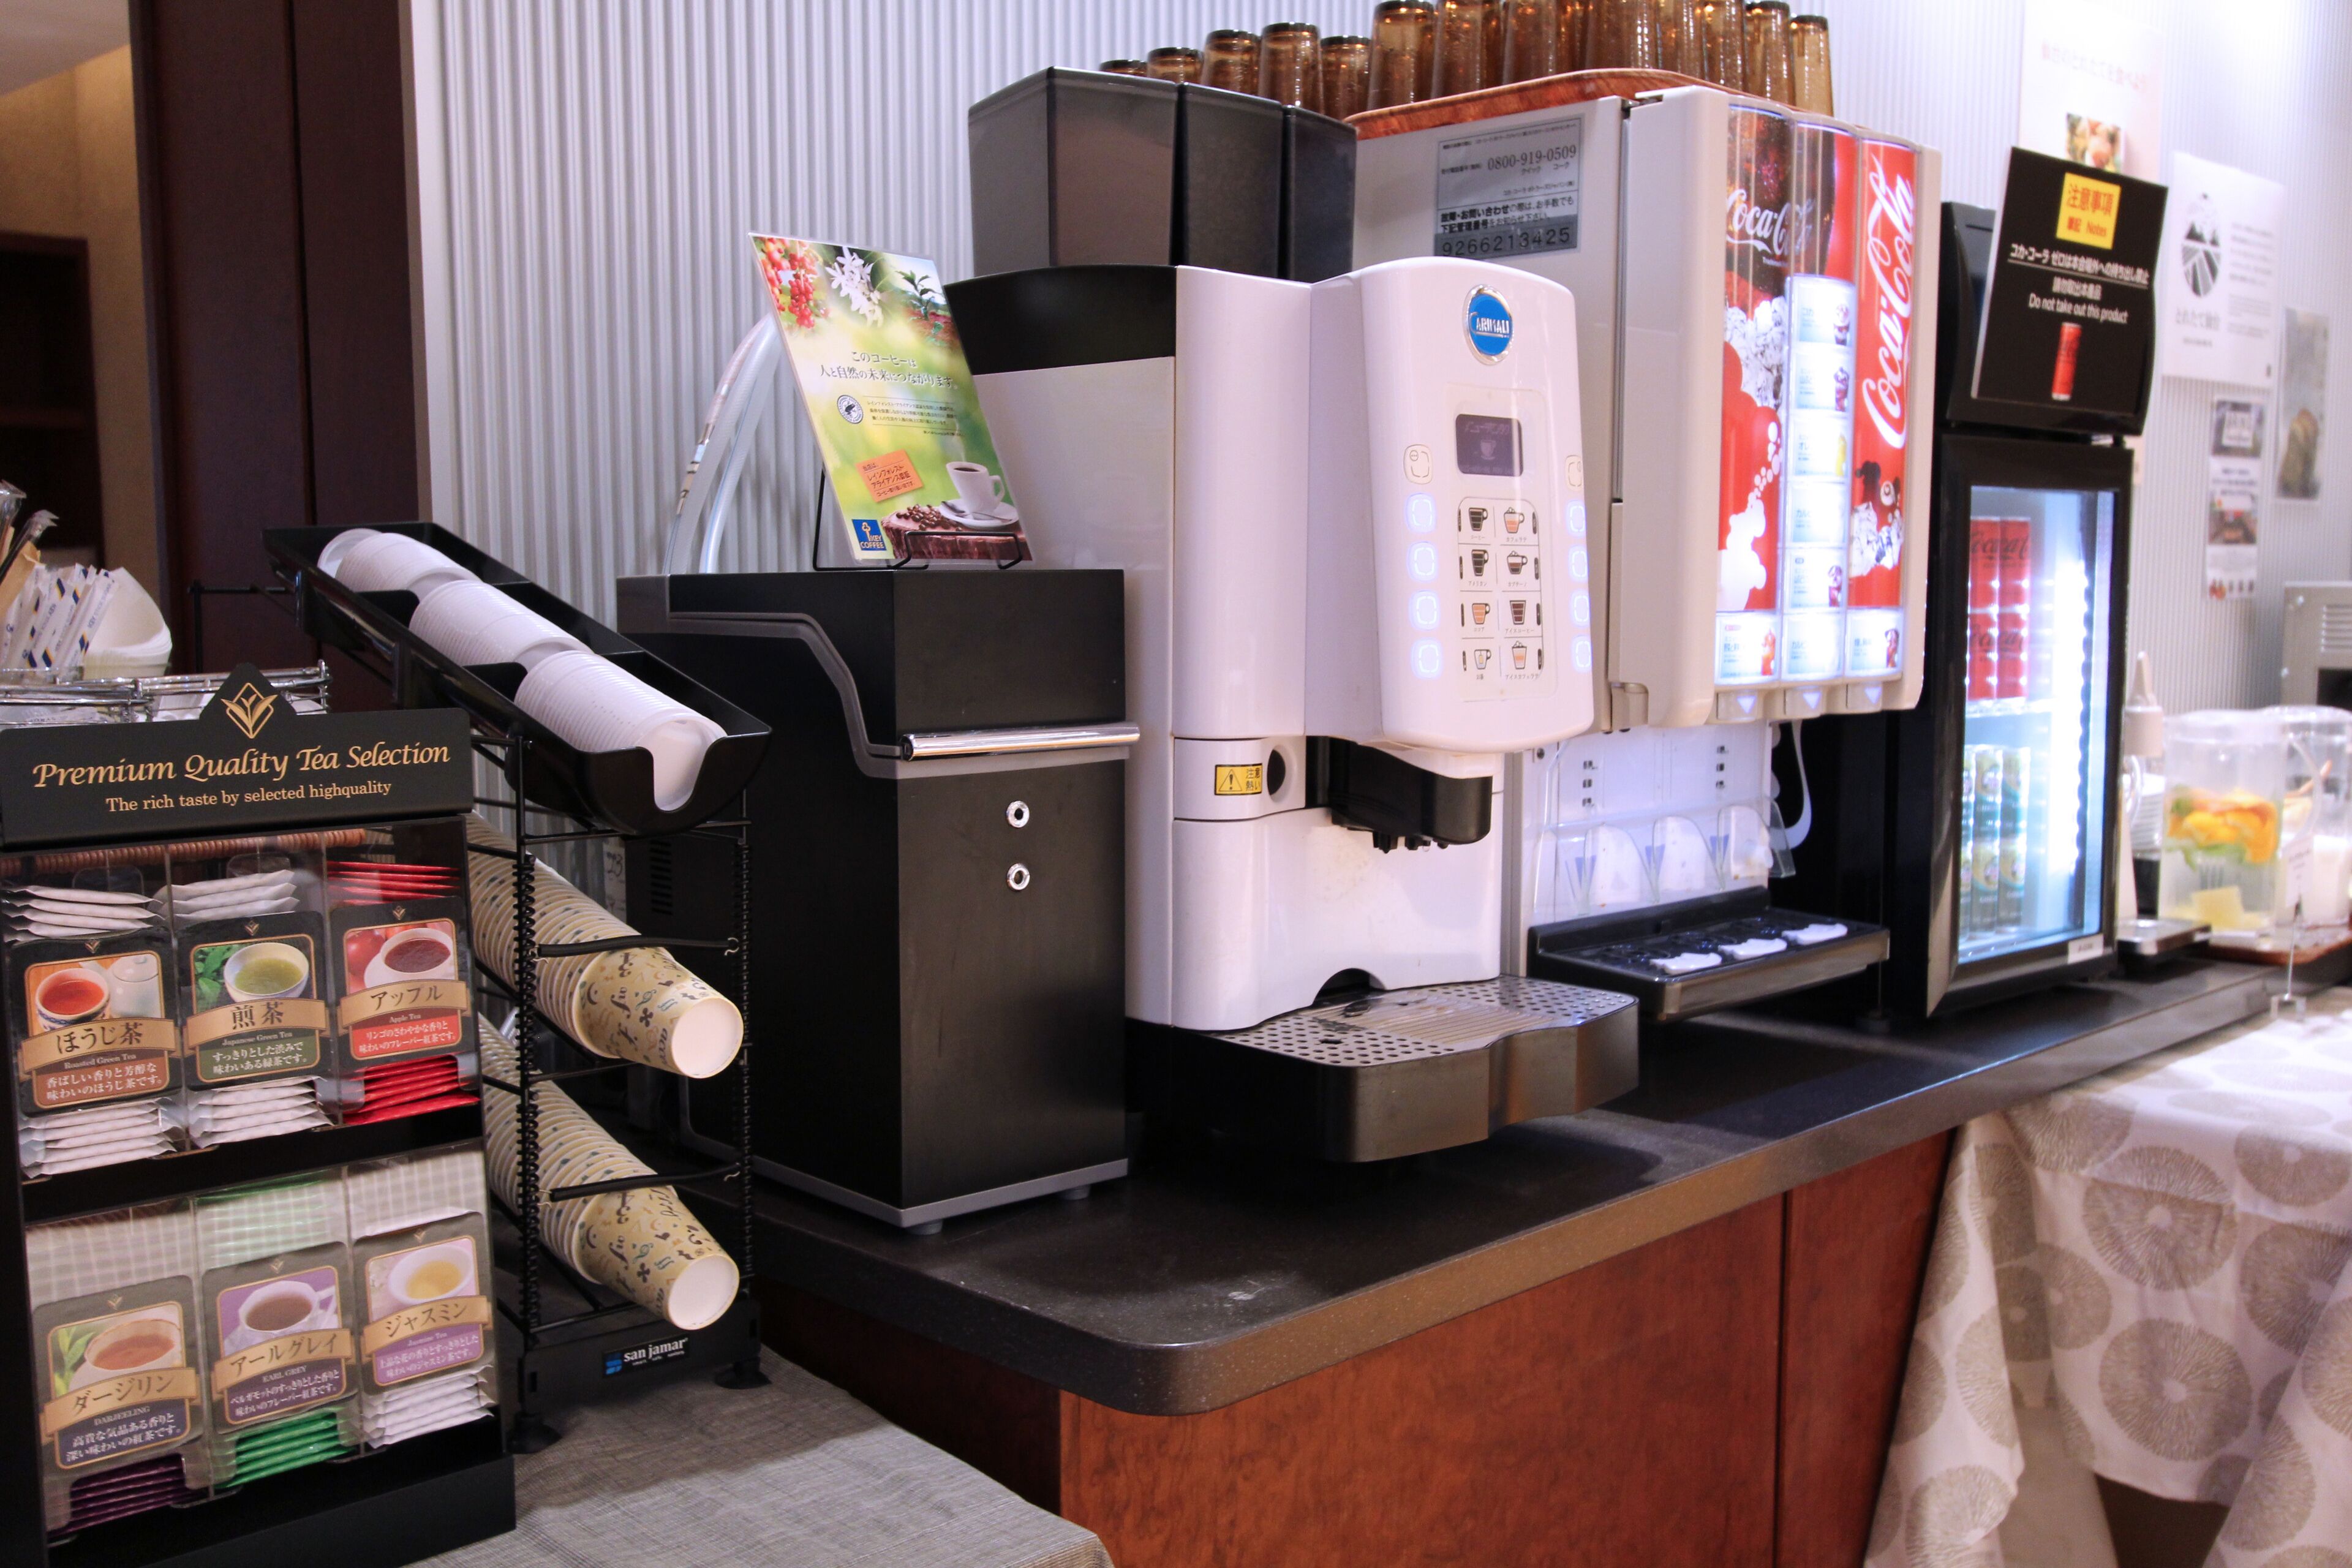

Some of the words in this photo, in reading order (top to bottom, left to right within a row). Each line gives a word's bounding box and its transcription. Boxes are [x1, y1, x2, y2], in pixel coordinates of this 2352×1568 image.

[1488, 145, 1577, 171] 0800-919-0509
[2067, 183, 2114, 217] 注意事項
[1442, 227, 1570, 255] 9266213425
[2086, 221, 2107, 236] Notes
[1863, 152, 1915, 450] Coca-Cola
[2029, 293, 2040, 309] Do
[2042, 295, 2055, 311] not
[2056, 297, 2073, 315] take
[2074, 303, 2086, 317] out
[2087, 303, 2100, 320] this
[2100, 307, 2128, 323] product
[851, 351, 917, 368] このコーヒーは
[820, 364, 959, 390] 人と自然の未来につながります。
[33, 757, 177, 788] Premium
[184, 748, 288, 782] Quality
[295, 746, 340, 771] Tea
[346, 741, 451, 769] Selection
[106, 796, 138, 812] The
[143, 794, 175, 810] rich
[179, 792, 217, 808] taste
[221, 790, 240, 807] by
[244, 784, 306, 802] selected
[309, 780, 392, 802] highquality
[370, 985, 443, 1011] アップル
[232, 1001, 284, 1031] 煎茶
[388, 1014, 408, 1024] Apple
[56, 1022, 143, 1055] ほうじ茶
[256, 1033, 278, 1042] Green
[366, 1020, 448, 1041] リンゴのさわやかな香りと
[64, 1058, 95, 1069] Roasted
[96, 1055, 121, 1065] Green
[212, 1042, 304, 1063] すっきりとした渋みで
[213, 1053, 307, 1075] 味わいある緑茶です。
[46, 1074, 162, 1101] 味わいのほうじ茶です。
[47, 1062, 157, 1089] 香ばしい香りと芳醇な
[385, 1303, 467, 1338] ジャスミン
[230, 1334, 337, 1376] アールグレイ
[623, 1348, 647, 1363] san
[262, 1372, 284, 1384] EARL
[285, 1365, 307, 1377] GREY
[74, 1375, 176, 1416] ダージリン
[93, 1406, 151, 1426] DARJEELING
